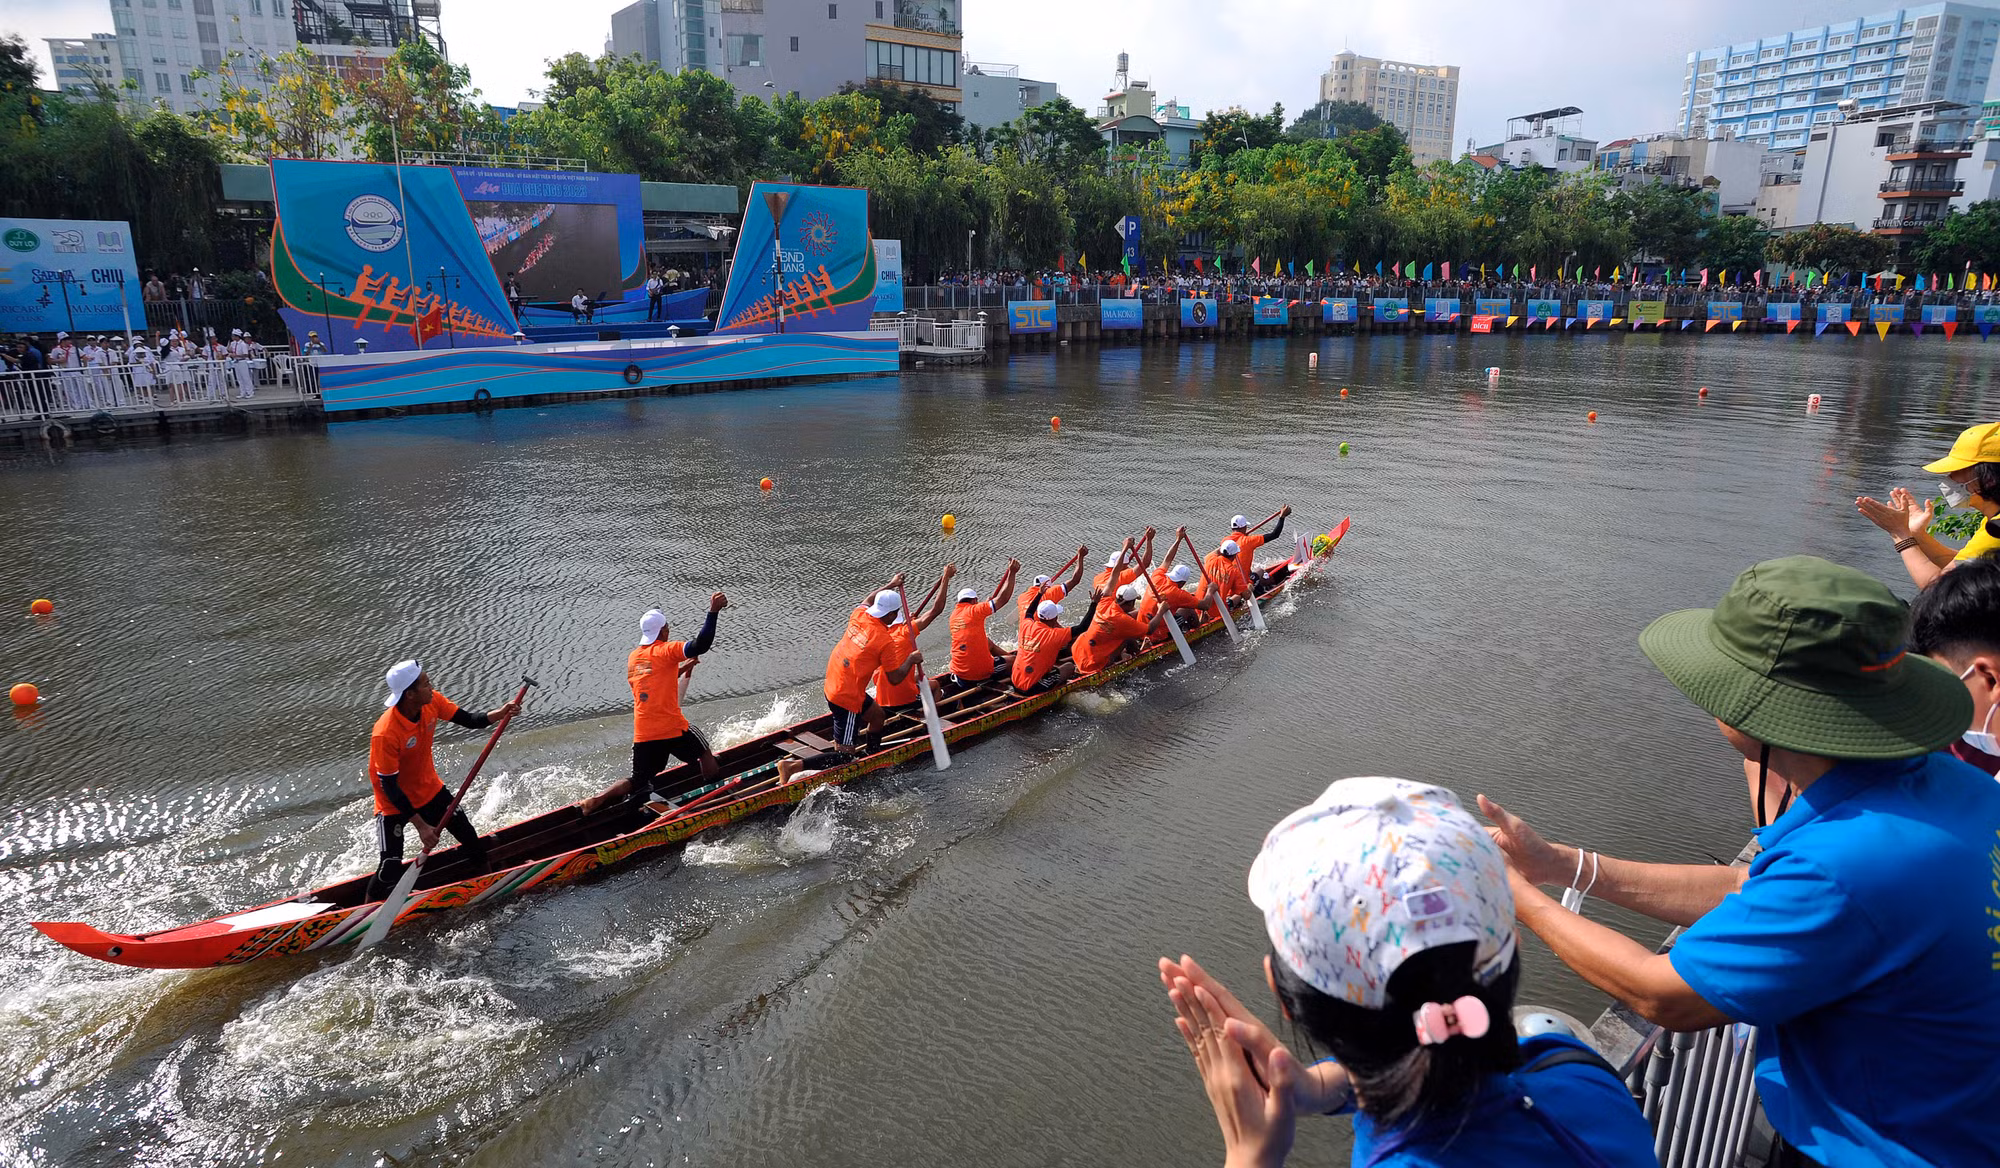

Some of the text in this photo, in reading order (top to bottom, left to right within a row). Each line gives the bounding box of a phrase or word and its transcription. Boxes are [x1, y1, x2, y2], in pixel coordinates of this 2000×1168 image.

[1128, 221, 1137, 236] P
[1127, 246, 1135, 258] 13
[1015, 306, 1052, 328] STC
[1812, 396, 1819, 405] 3
